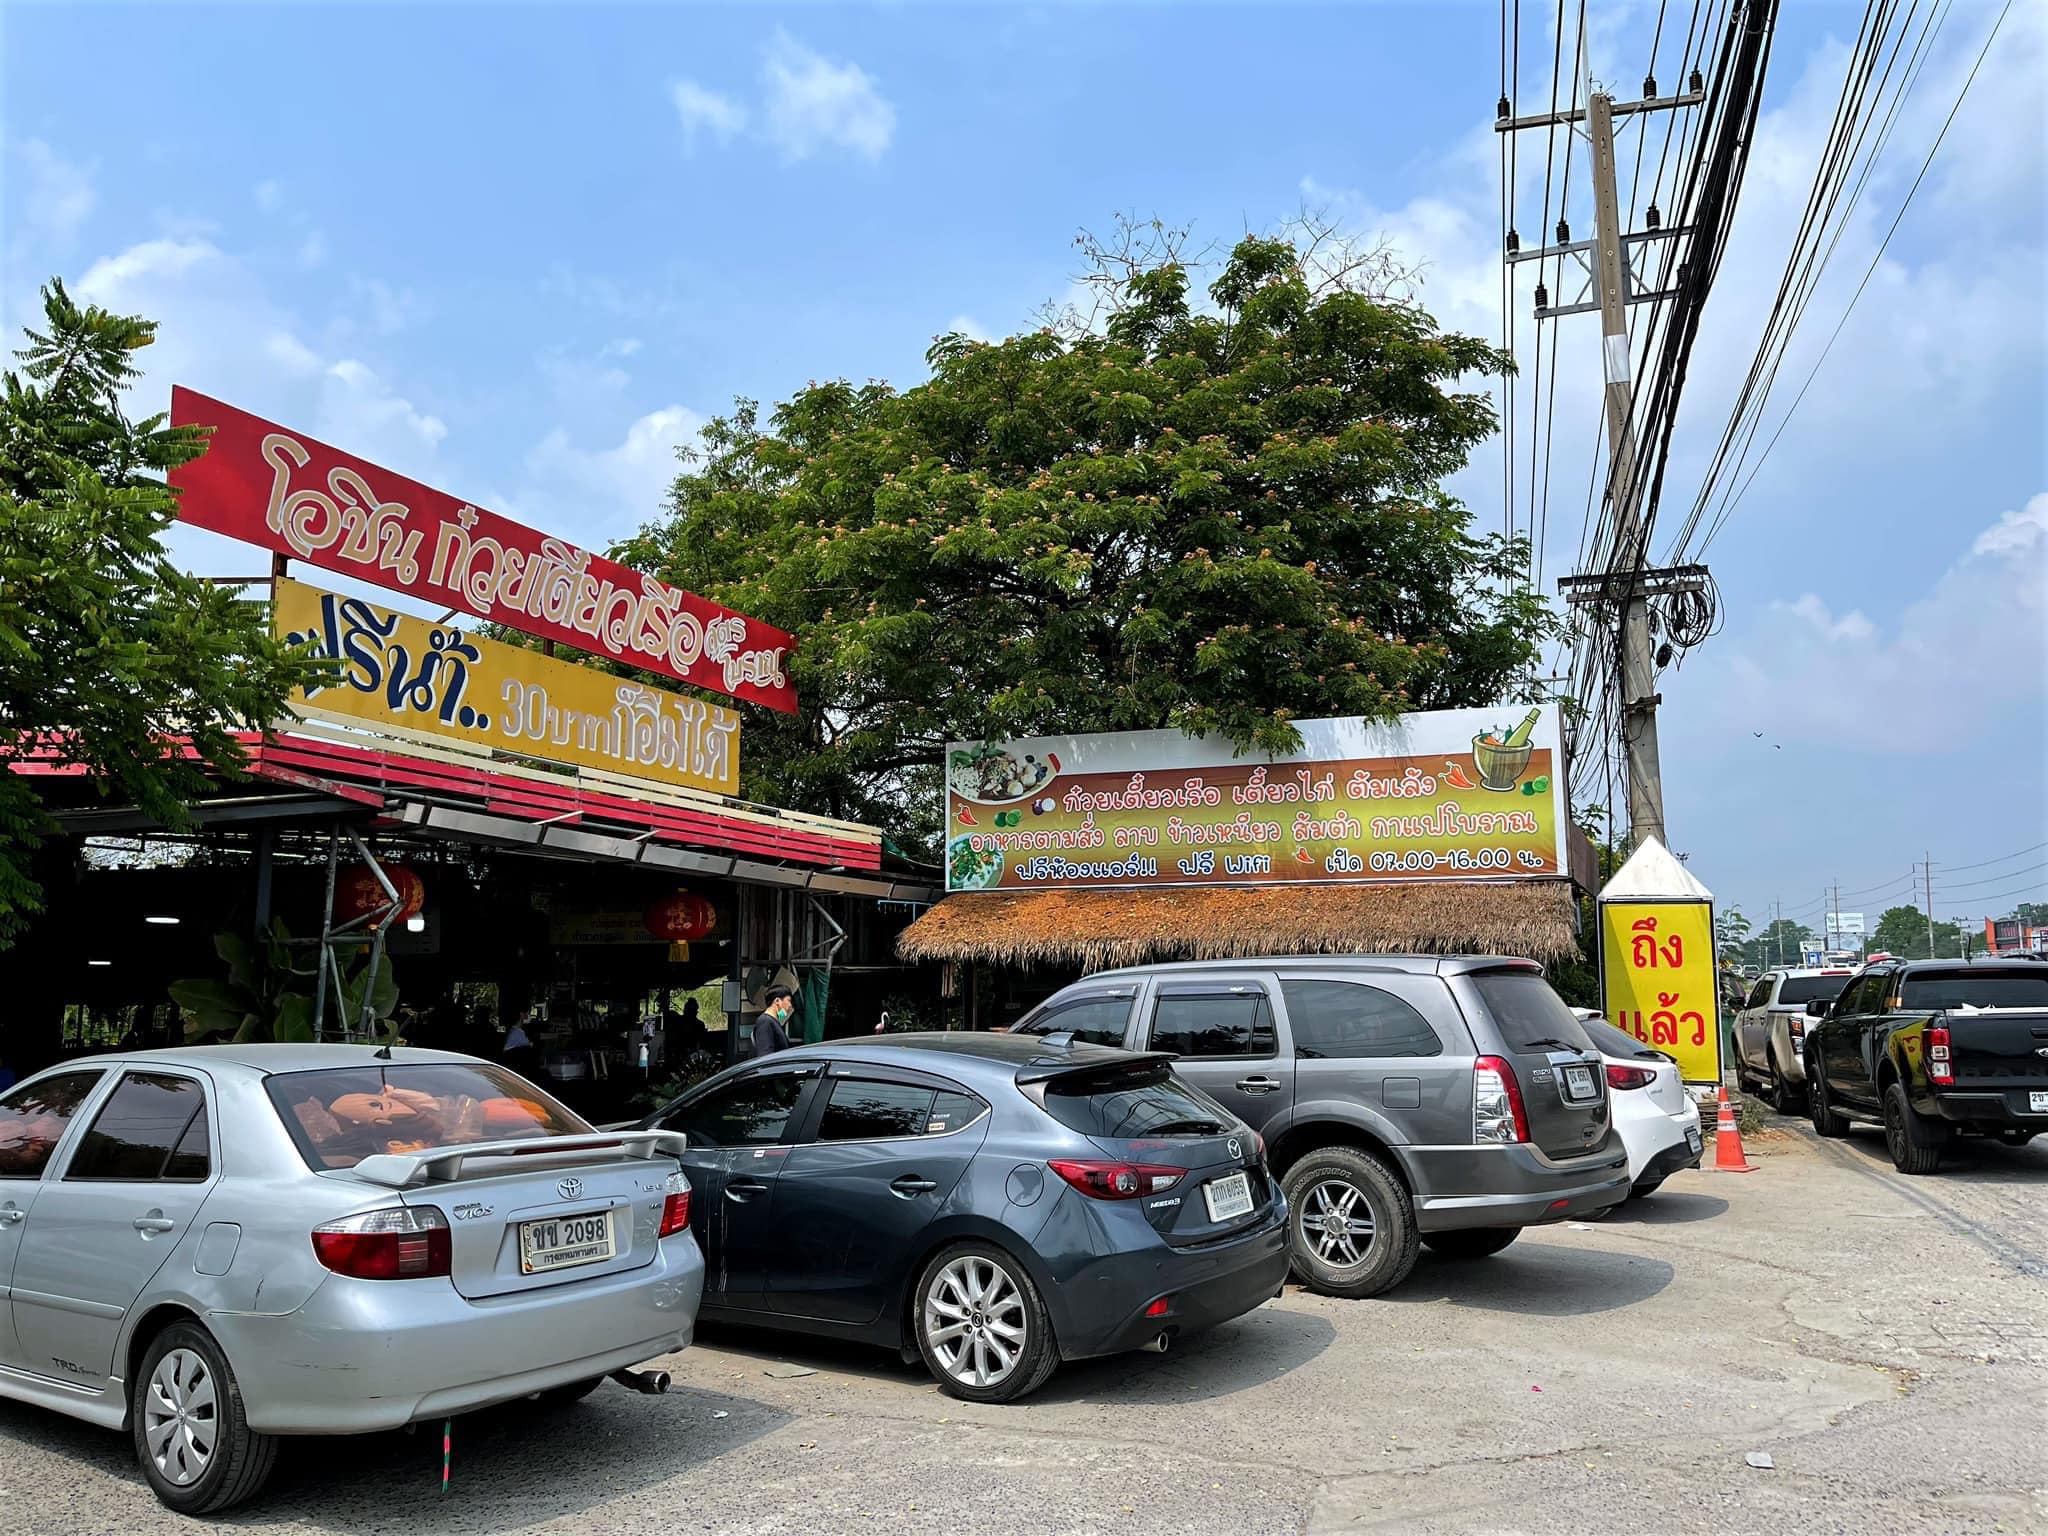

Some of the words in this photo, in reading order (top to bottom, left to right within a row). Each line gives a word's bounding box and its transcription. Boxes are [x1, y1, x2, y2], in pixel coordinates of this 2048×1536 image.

[428, 504, 703, 676] ก๋วยเตี๋ยวเรือ
[704, 611, 747, 664] สูตร
[717, 643, 787, 692] โบราณ
[1063, 773, 1220, 813] ก๋วยเตี๋ยวเรือ
[1232, 766, 1335, 805] เตี๋ยวไก่
[1346, 767, 1437, 799] ต้มเล้ง
[969, 813, 1105, 852] อาหารตามสั่ง
[1114, 824, 1158, 848] ลาบ
[1167, 812, 1281, 845] ข้าวเหนียว
[1292, 809, 1361, 841] ส้มตำ
[1371, 801, 1538, 839] กาแฟโบราณ
[1015, 853, 1157, 881] ฟรีห้องแอร์!!
[1177, 850, 1216, 876] ฟรี
[1225, 854, 1272, 874] Wifi
[1325, 849, 1363, 874] เปิด
[1369, 848, 1510, 871] 07.00-16.00
[1517, 850, 1544, 868] น.
[1631, 916, 1683, 969] ถึง
[1617, 991, 1706, 1047] แล้ว
[544, 1247, 599, 1264] กรุงเทพมหานคร
[564, 1218, 605, 1246] 2098
